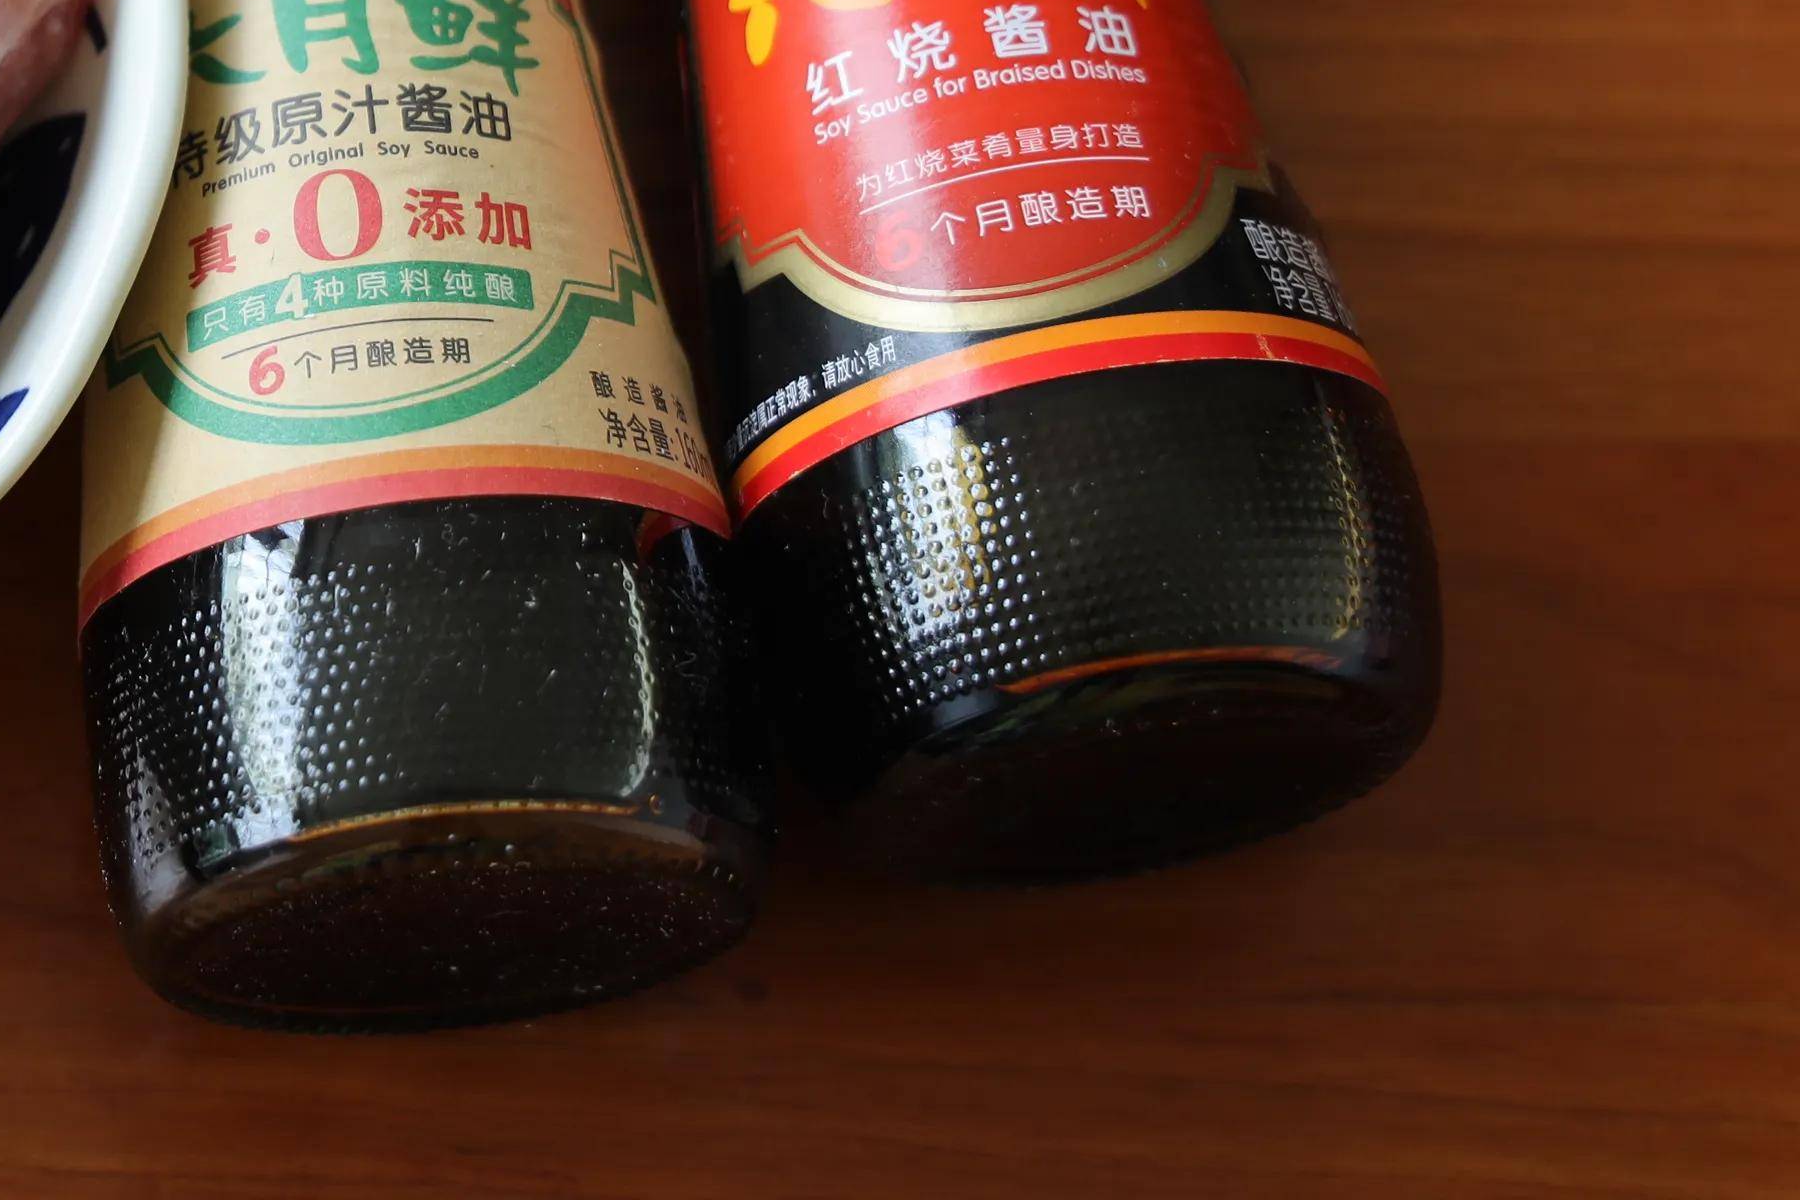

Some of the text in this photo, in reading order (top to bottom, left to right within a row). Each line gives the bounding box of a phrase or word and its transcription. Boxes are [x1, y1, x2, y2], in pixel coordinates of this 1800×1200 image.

[805, 3, 1138, 116] 红烧酱油
[171, 82, 513, 190] 特级原汁酱油
[813, 58, 1147, 146] Soy Sauce for Braised Dishes
[201, 139, 481, 198] Premium Original Soy Sauce
[855, 122, 1144, 202] 为红烧菜肴量身打造
[875, 185, 1151, 272] 6个月酿造期
[1239, 218, 1338, 284] 酿造酱
[202, 267, 519, 341] 只有4种原料纯酿
[248, 336, 472, 397] 6个月酿造期
